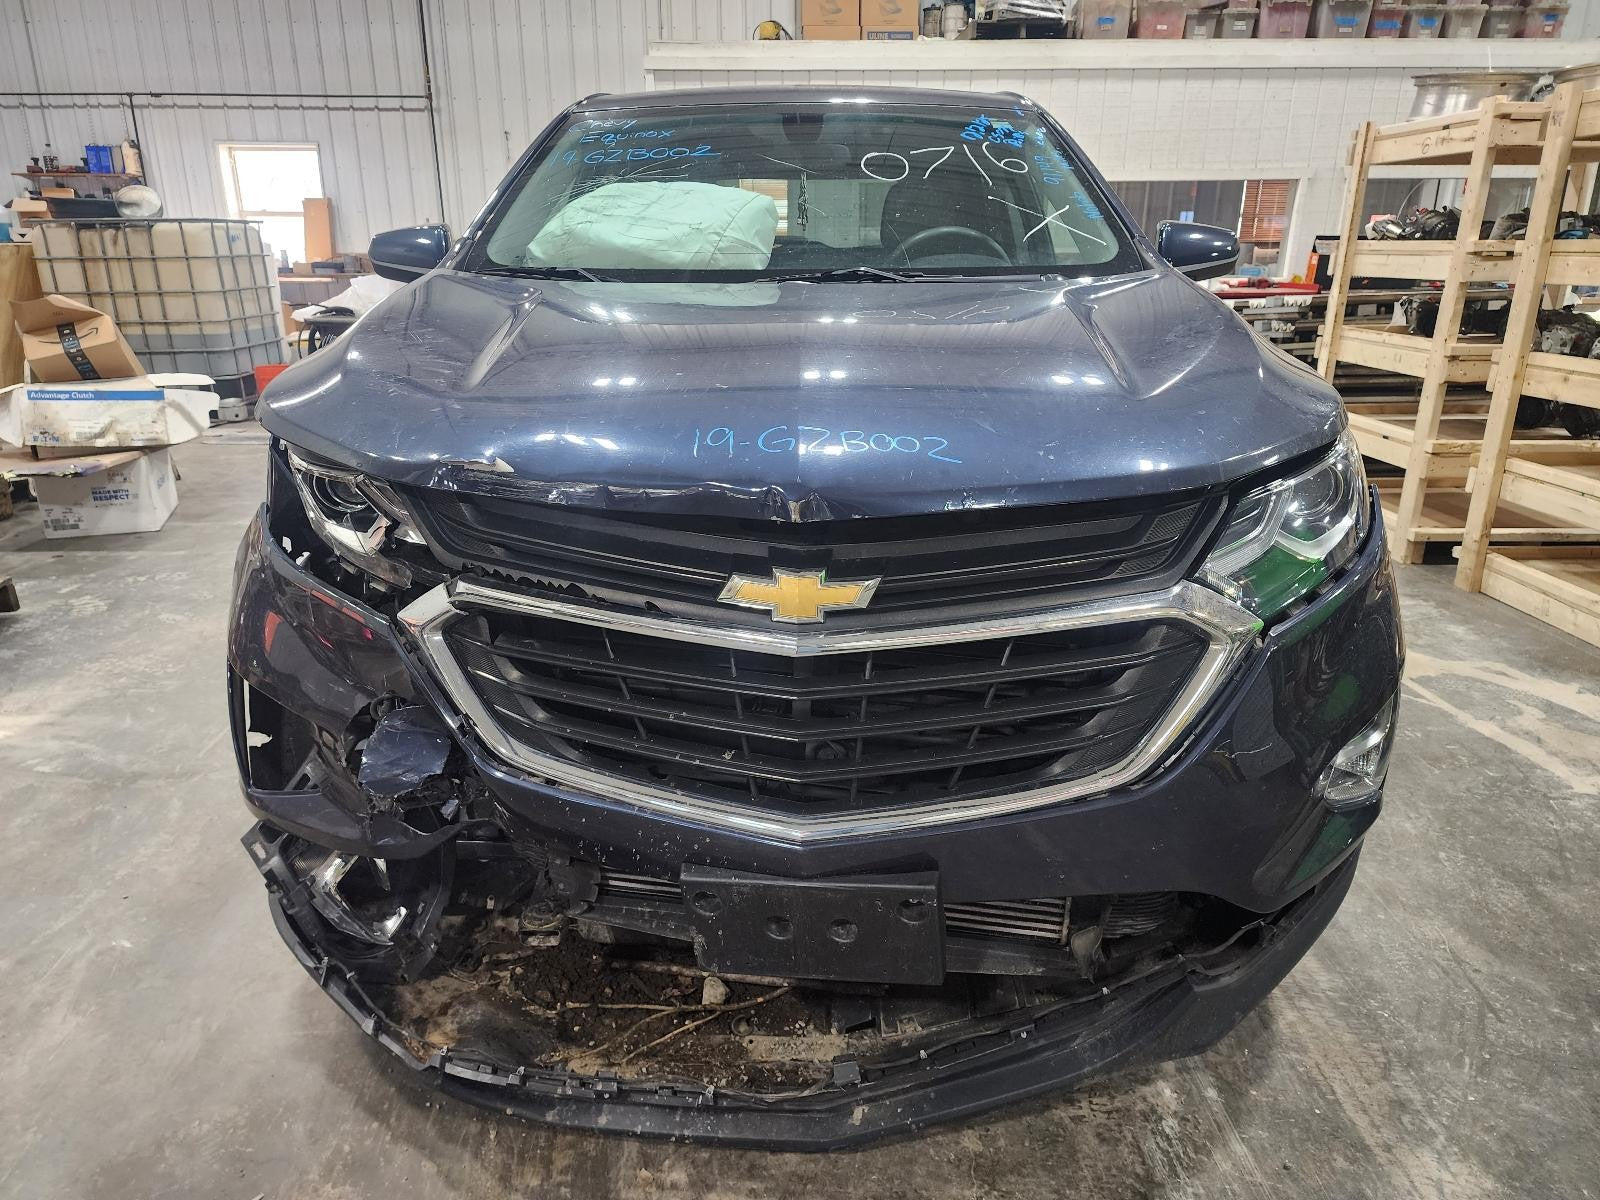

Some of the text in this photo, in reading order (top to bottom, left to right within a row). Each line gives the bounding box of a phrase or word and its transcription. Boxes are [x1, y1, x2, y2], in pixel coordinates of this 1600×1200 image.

[579, 129, 677, 149] Equinox
[861, 142, 1029, 187] 0716
[30, 391, 95, 400] Advantage Clutch
[693, 426, 963, 464] 19-GZB002
[93, 494, 130, 502] RESPECT
